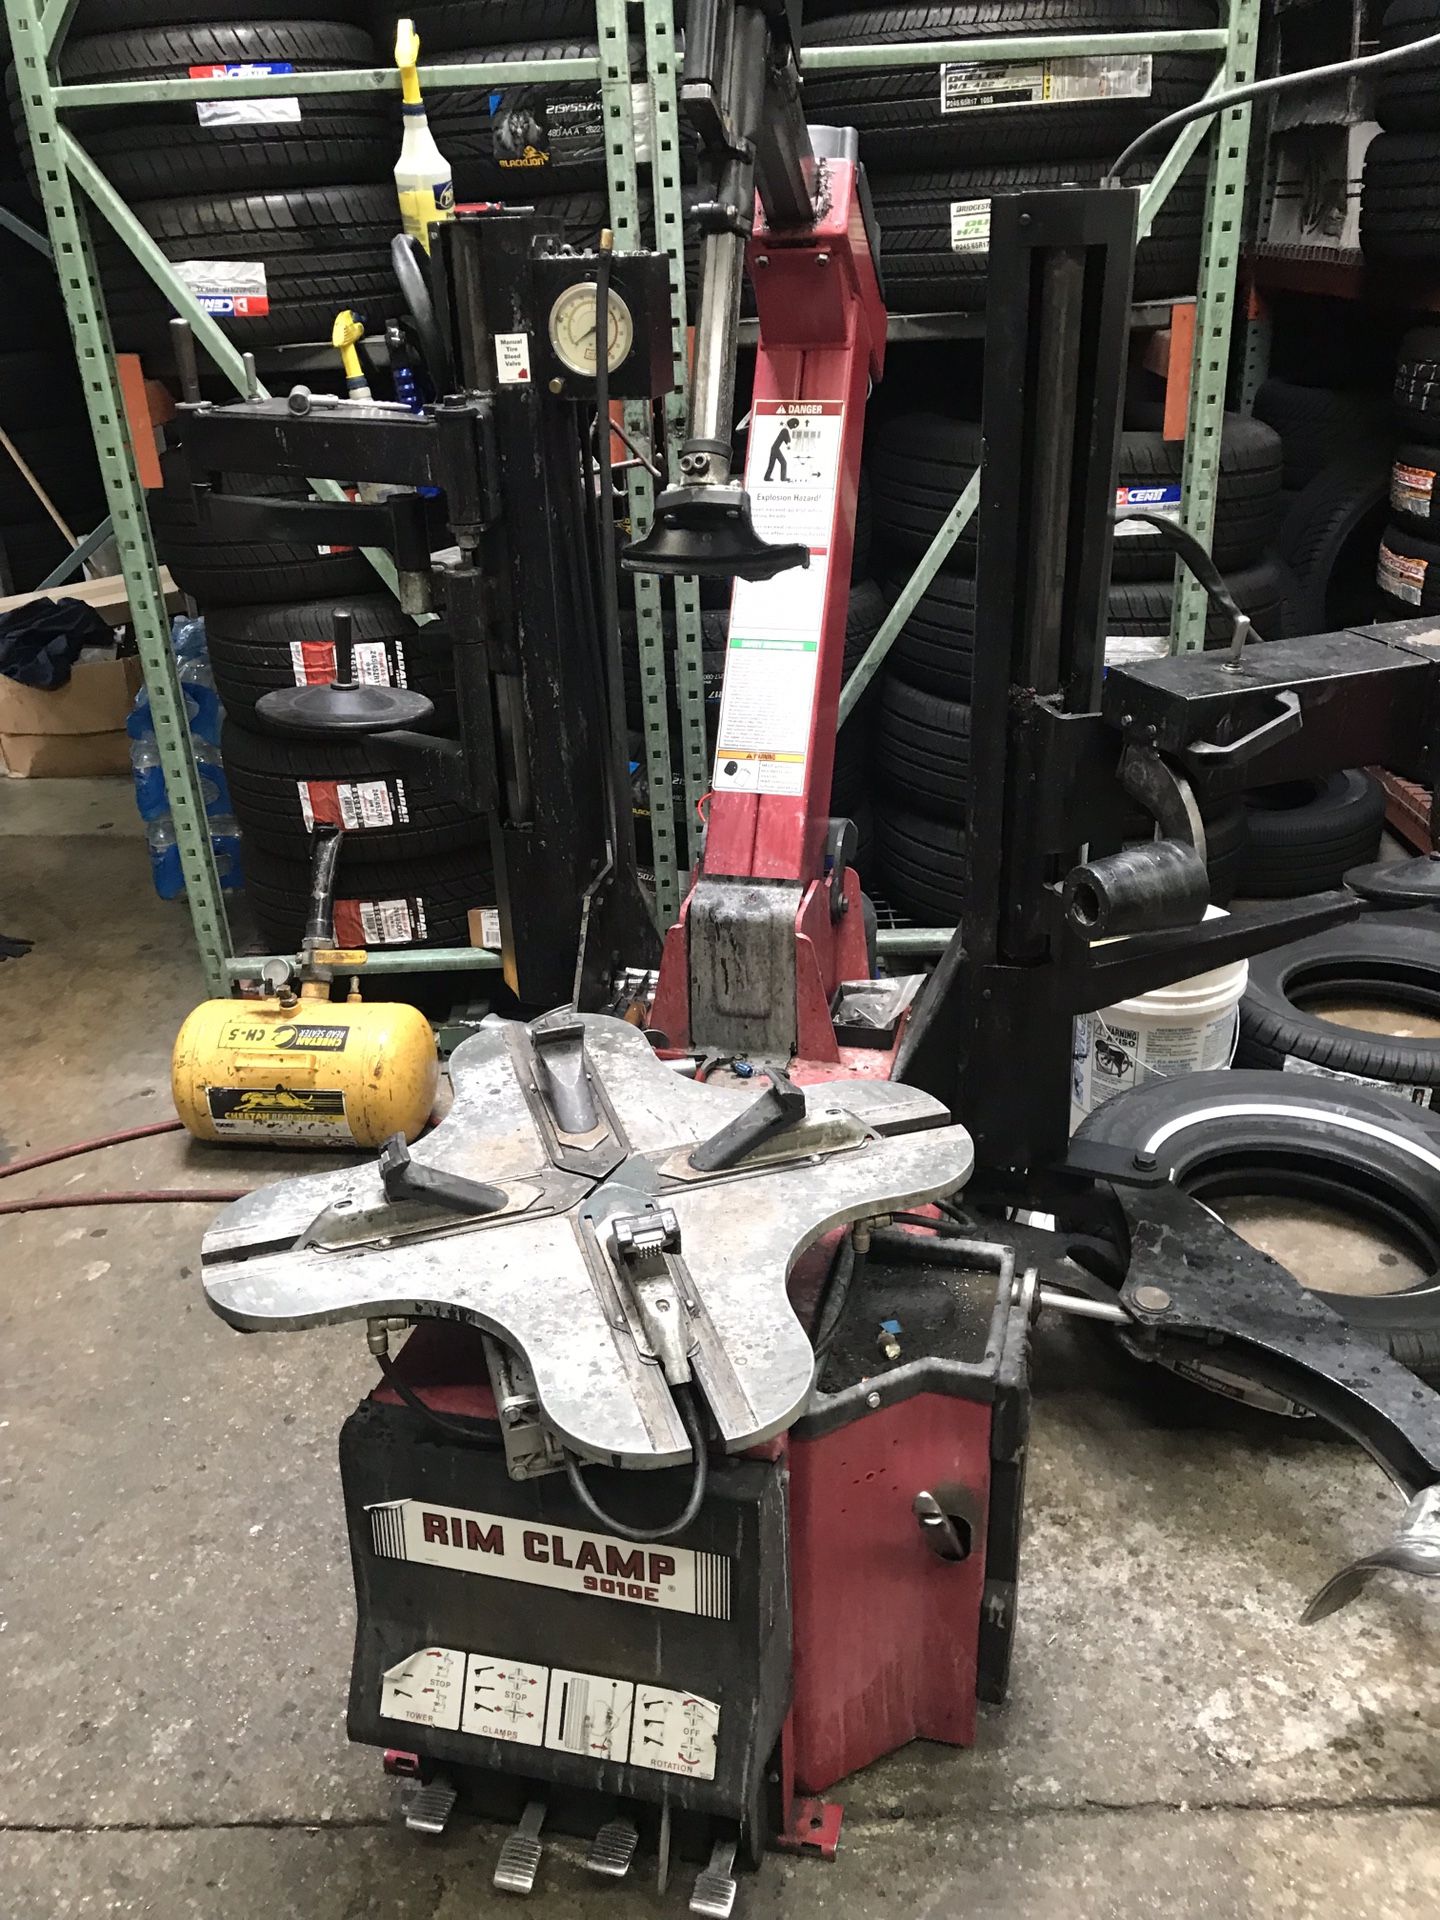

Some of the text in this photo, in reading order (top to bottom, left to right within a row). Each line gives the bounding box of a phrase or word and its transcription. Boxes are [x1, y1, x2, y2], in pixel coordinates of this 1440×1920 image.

[788, 404, 823, 415] DANGER
[756, 492, 822, 502] Explosion Hazard!
[395, 640, 408, 689] RADAR
[395, 779, 410, 823] RADAR
[228, 1028, 266, 1041] CH-5
[295, 1037, 343, 1047] CHEETAH
[224, 1111, 270, 1120] CHEETAH
[421, 1511, 677, 1585] RIM CLAMP
[582, 1574, 660, 1603] 9010E
[429, 1678, 452, 1689] STOP
[504, 1690, 528, 1701] STOP
[405, 1710, 435, 1723] TOWER
[482, 1725, 519, 1740] CLAMPS
[683, 1727, 701, 1737] OFF
[650, 1758, 694, 1774] ROTATION
